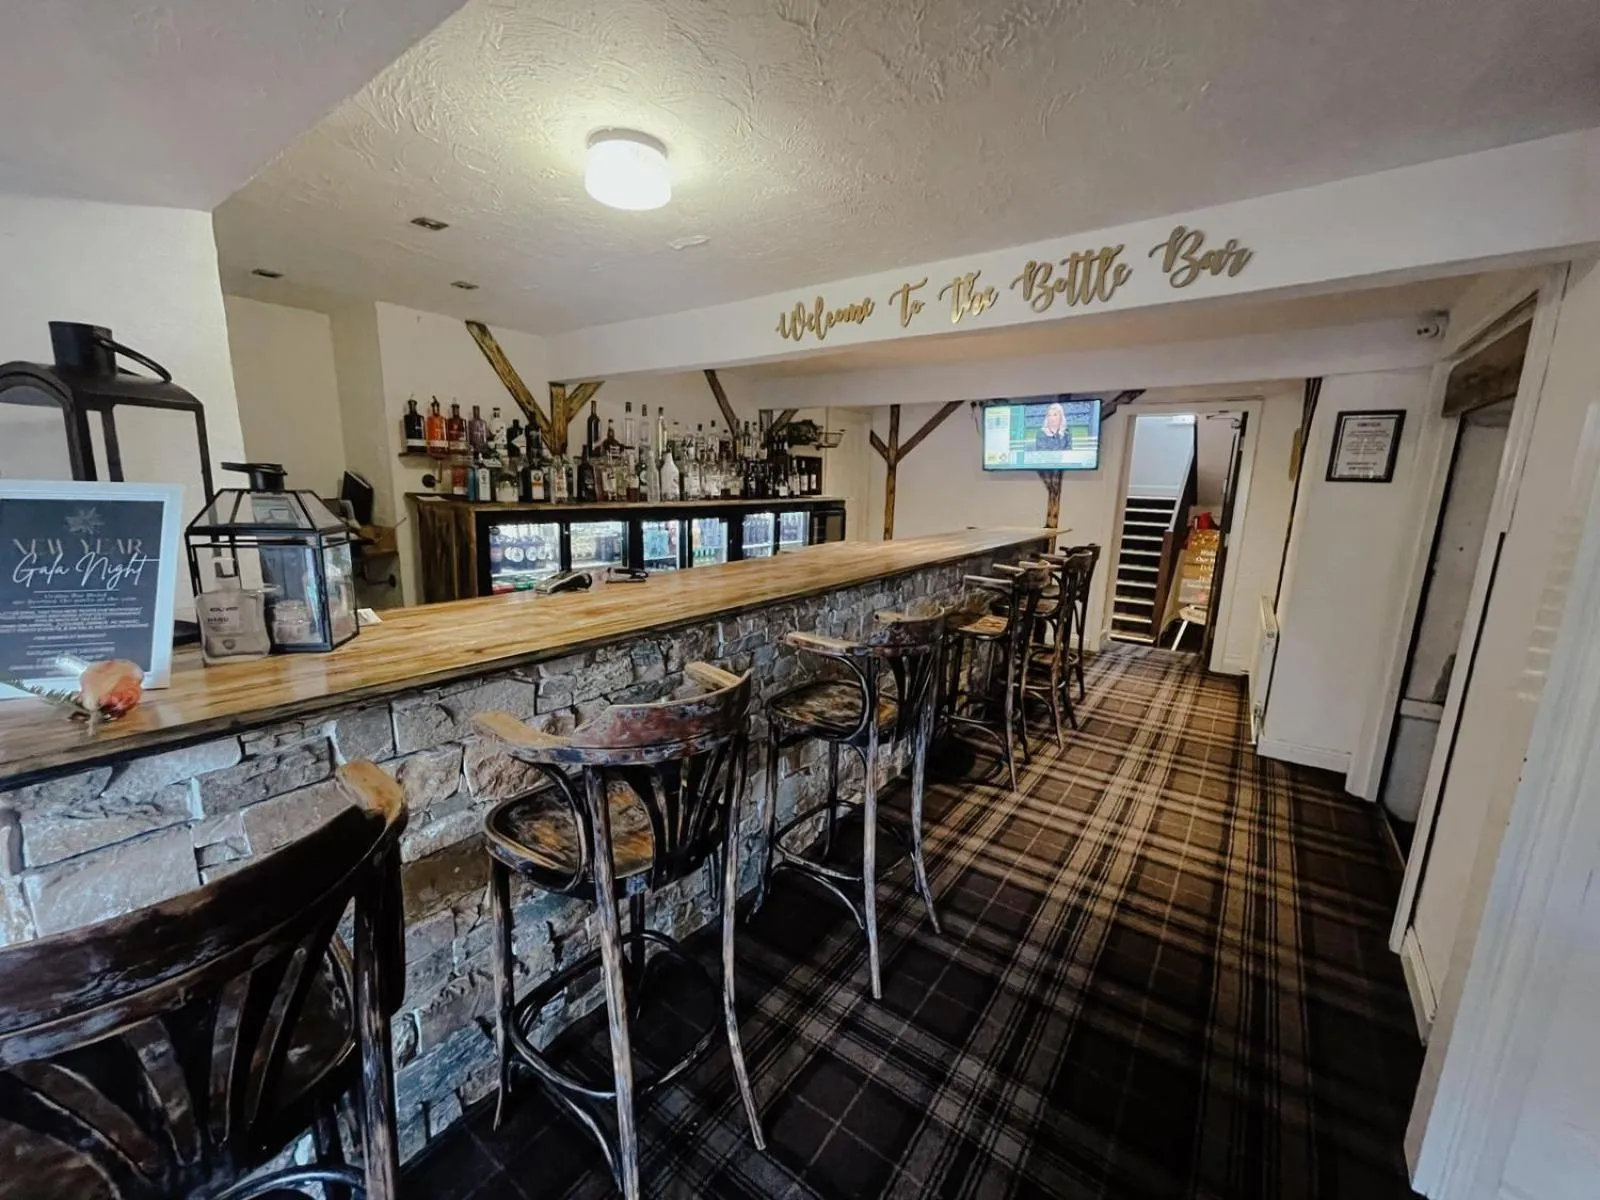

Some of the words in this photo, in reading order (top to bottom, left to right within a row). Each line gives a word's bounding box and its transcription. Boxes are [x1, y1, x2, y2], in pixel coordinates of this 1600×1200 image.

[775, 296, 875, 341] Welcome
[1009, 243, 1133, 313] Bottle
[1148, 225, 1253, 288] Bar
[12, 551, 70, 588] Gala
[75, 551, 160, 591] Night
